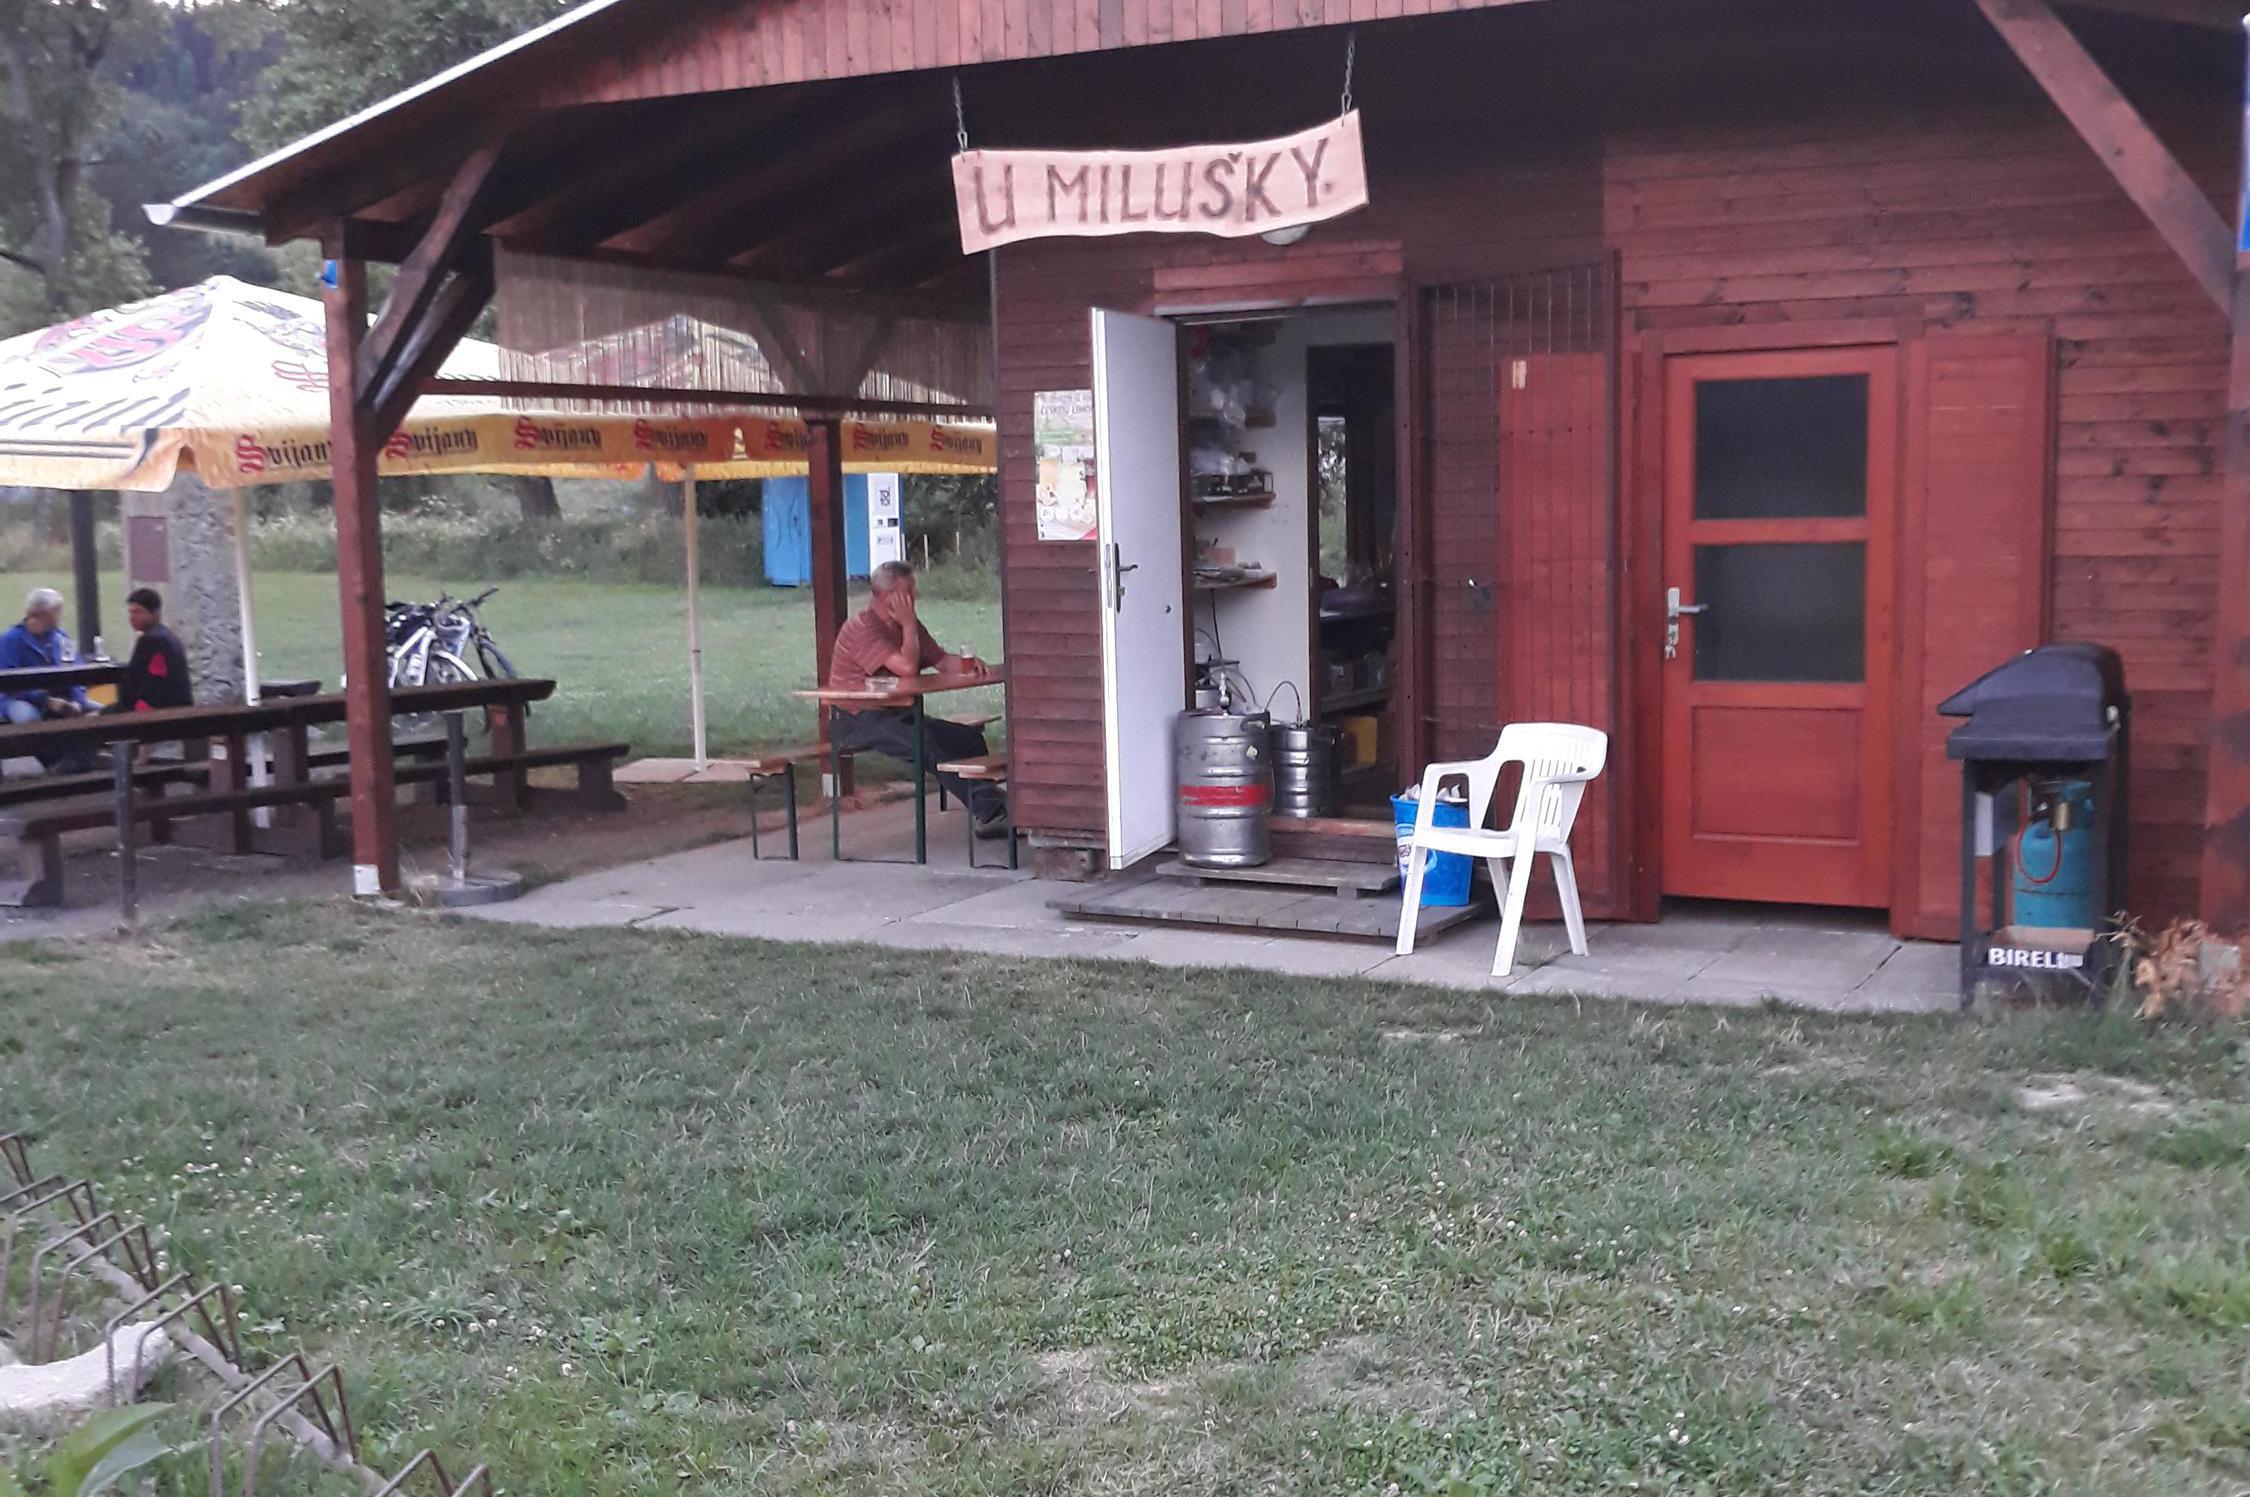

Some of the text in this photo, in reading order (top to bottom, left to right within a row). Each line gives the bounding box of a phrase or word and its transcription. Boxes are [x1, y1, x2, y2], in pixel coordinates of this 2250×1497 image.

[972, 163, 1016, 236] U
[514, 415, 602, 450] Svijany
[634, 418, 708, 450] Svijany
[852, 422, 909, 451] Svijany
[929, 424, 983, 456] Svijany
